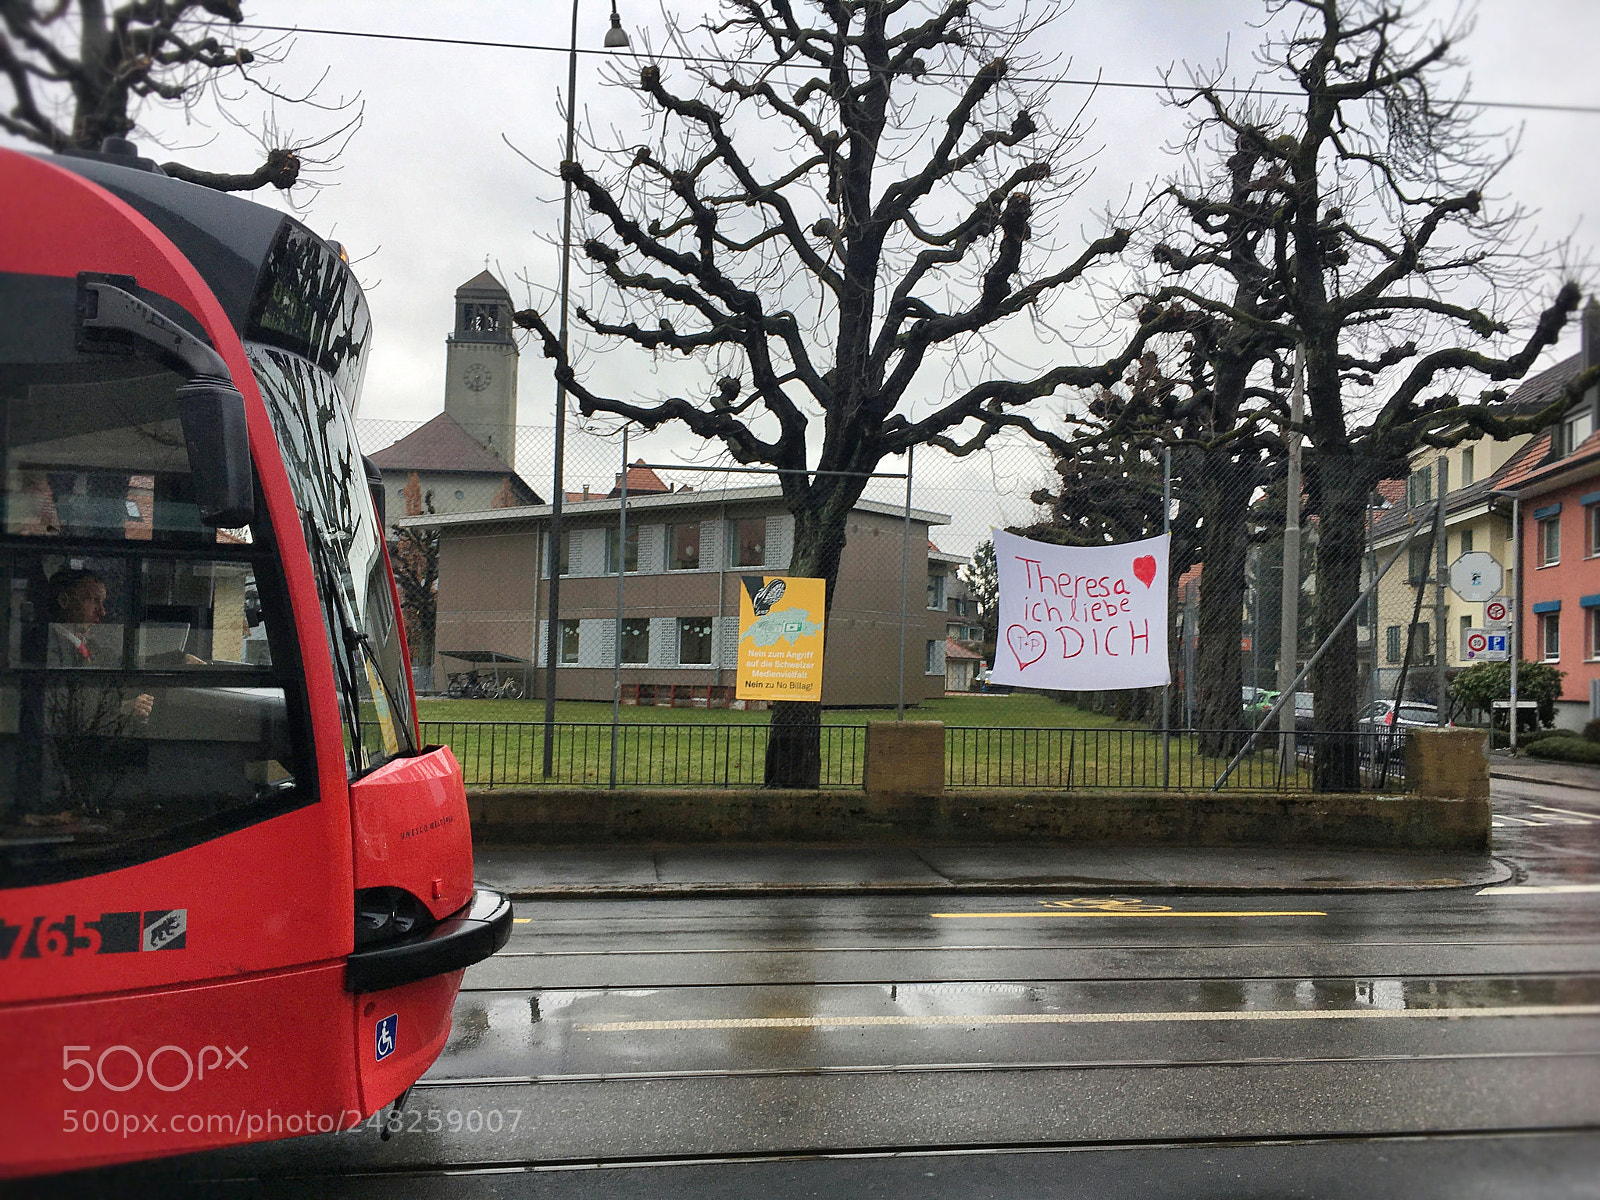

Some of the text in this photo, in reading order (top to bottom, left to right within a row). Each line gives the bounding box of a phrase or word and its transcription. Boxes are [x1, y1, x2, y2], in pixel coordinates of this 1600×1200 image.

[1015, 556, 1131, 598] Theresa
[1025, 597, 1131, 622] ich liebe
[1055, 618, 1149, 659] DICH
[774, 660, 815, 669] Schweizer
[786, 651, 814, 660] Angriff
[752, 670, 808, 678] Medienvielfalt
[745, 680, 763, 688] Nein
[789, 682, 814, 691] Billag!
[3, 913, 102, 960] 765
